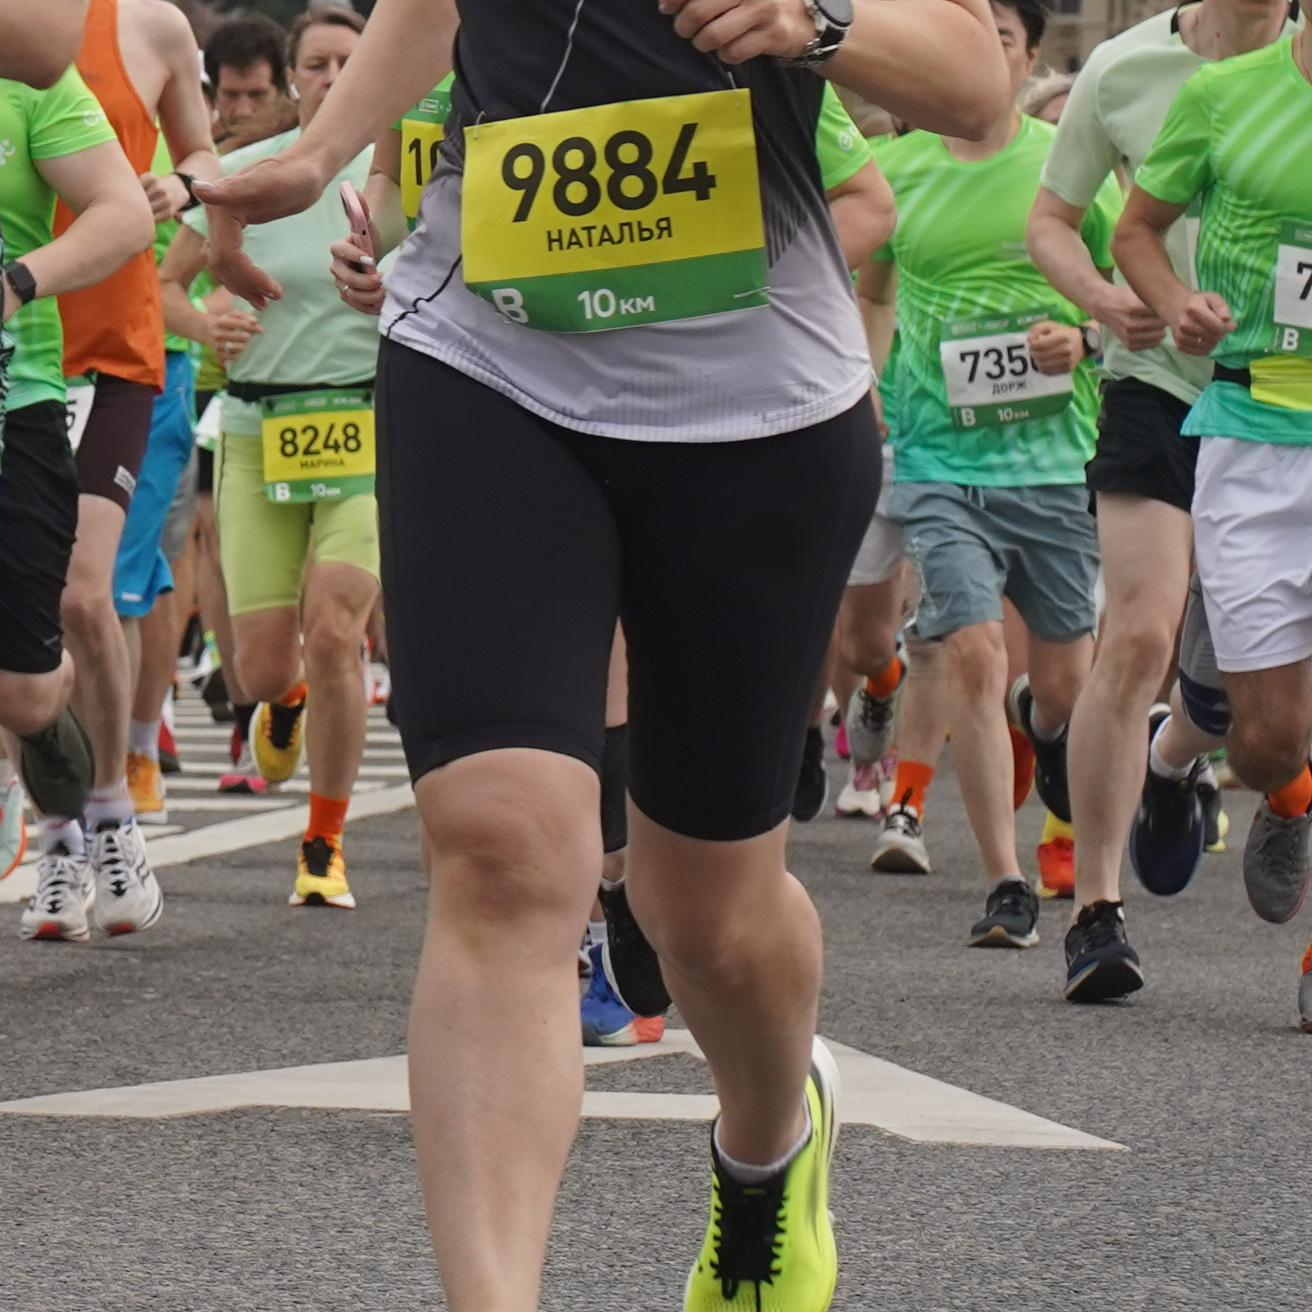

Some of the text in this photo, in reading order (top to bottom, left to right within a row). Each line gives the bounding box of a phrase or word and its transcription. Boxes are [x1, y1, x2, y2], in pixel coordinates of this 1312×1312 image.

[501, 122, 717, 223] 9884
[547, 217, 674, 252] НАТАЛЬЯ
[959, 343, 1040, 384] 735
[279, 422, 362, 458] 8248
